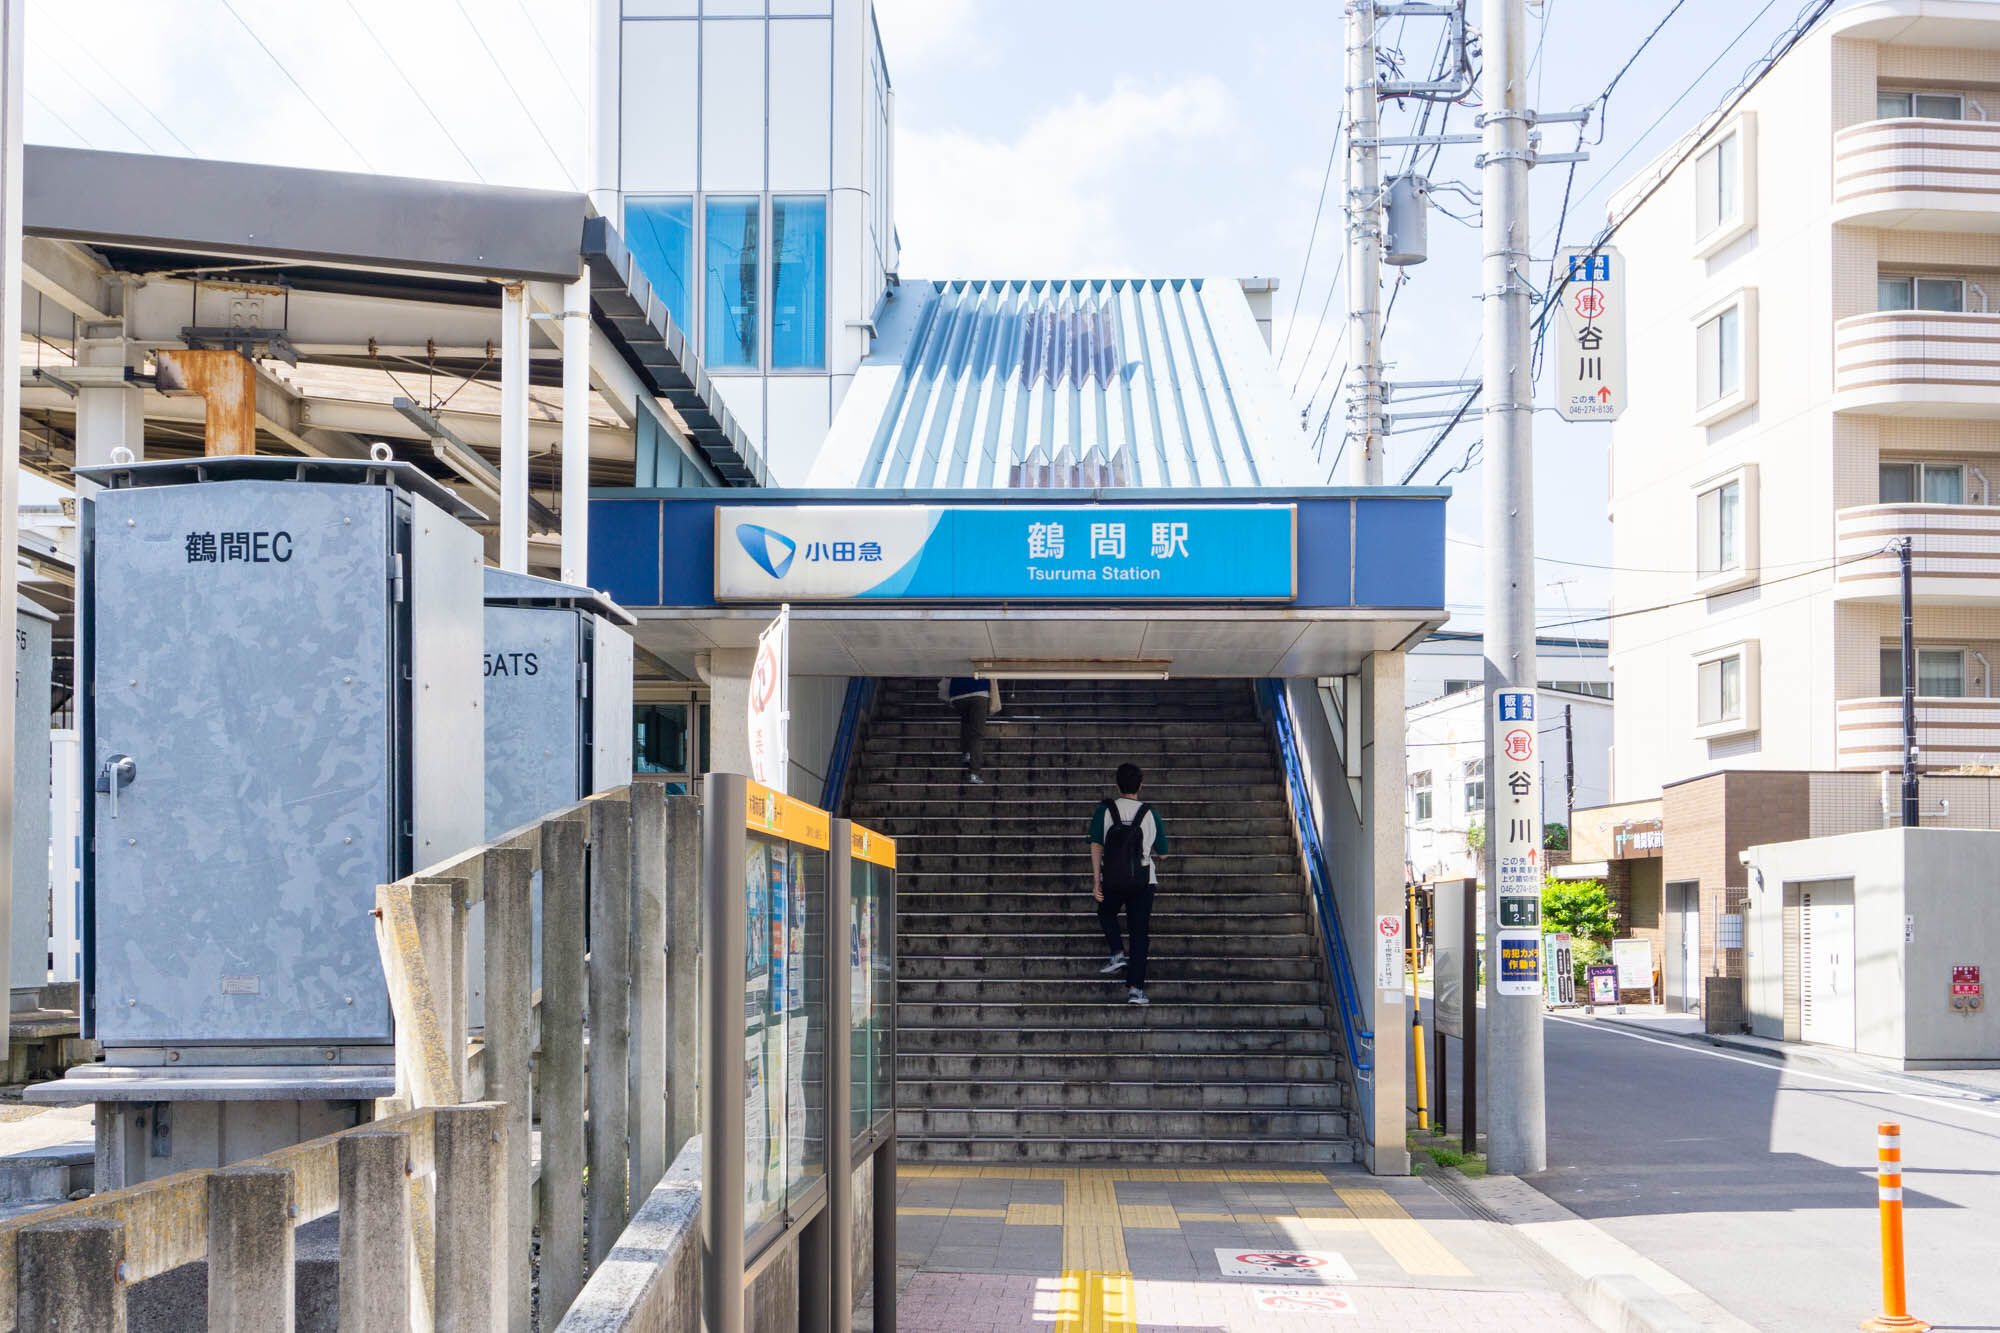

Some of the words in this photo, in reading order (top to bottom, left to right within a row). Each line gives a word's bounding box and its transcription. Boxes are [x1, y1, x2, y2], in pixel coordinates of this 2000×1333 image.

[1582, 295, 1597, 312] 質
[1579, 326, 1602, 381] 谷川
[1571, 395, 1596, 404] この先
[185, 531, 293, 563] 鶴間EC
[1027, 522, 1190, 560] 鶴間駅
[805, 541, 883, 563] 小田急
[1027, 566, 1096, 581] Tsuruma
[1101, 566, 1161, 581] Station
[1504, 695, 1532, 706] 販売
[1504, 707, 1532, 719] 買取
[1512, 737, 1527, 754] 質
[1502, 857, 1526, 865] この先
[1513, 913, 1532, 922] 2-1
[1509, 960, 1537, 969] 作動中
